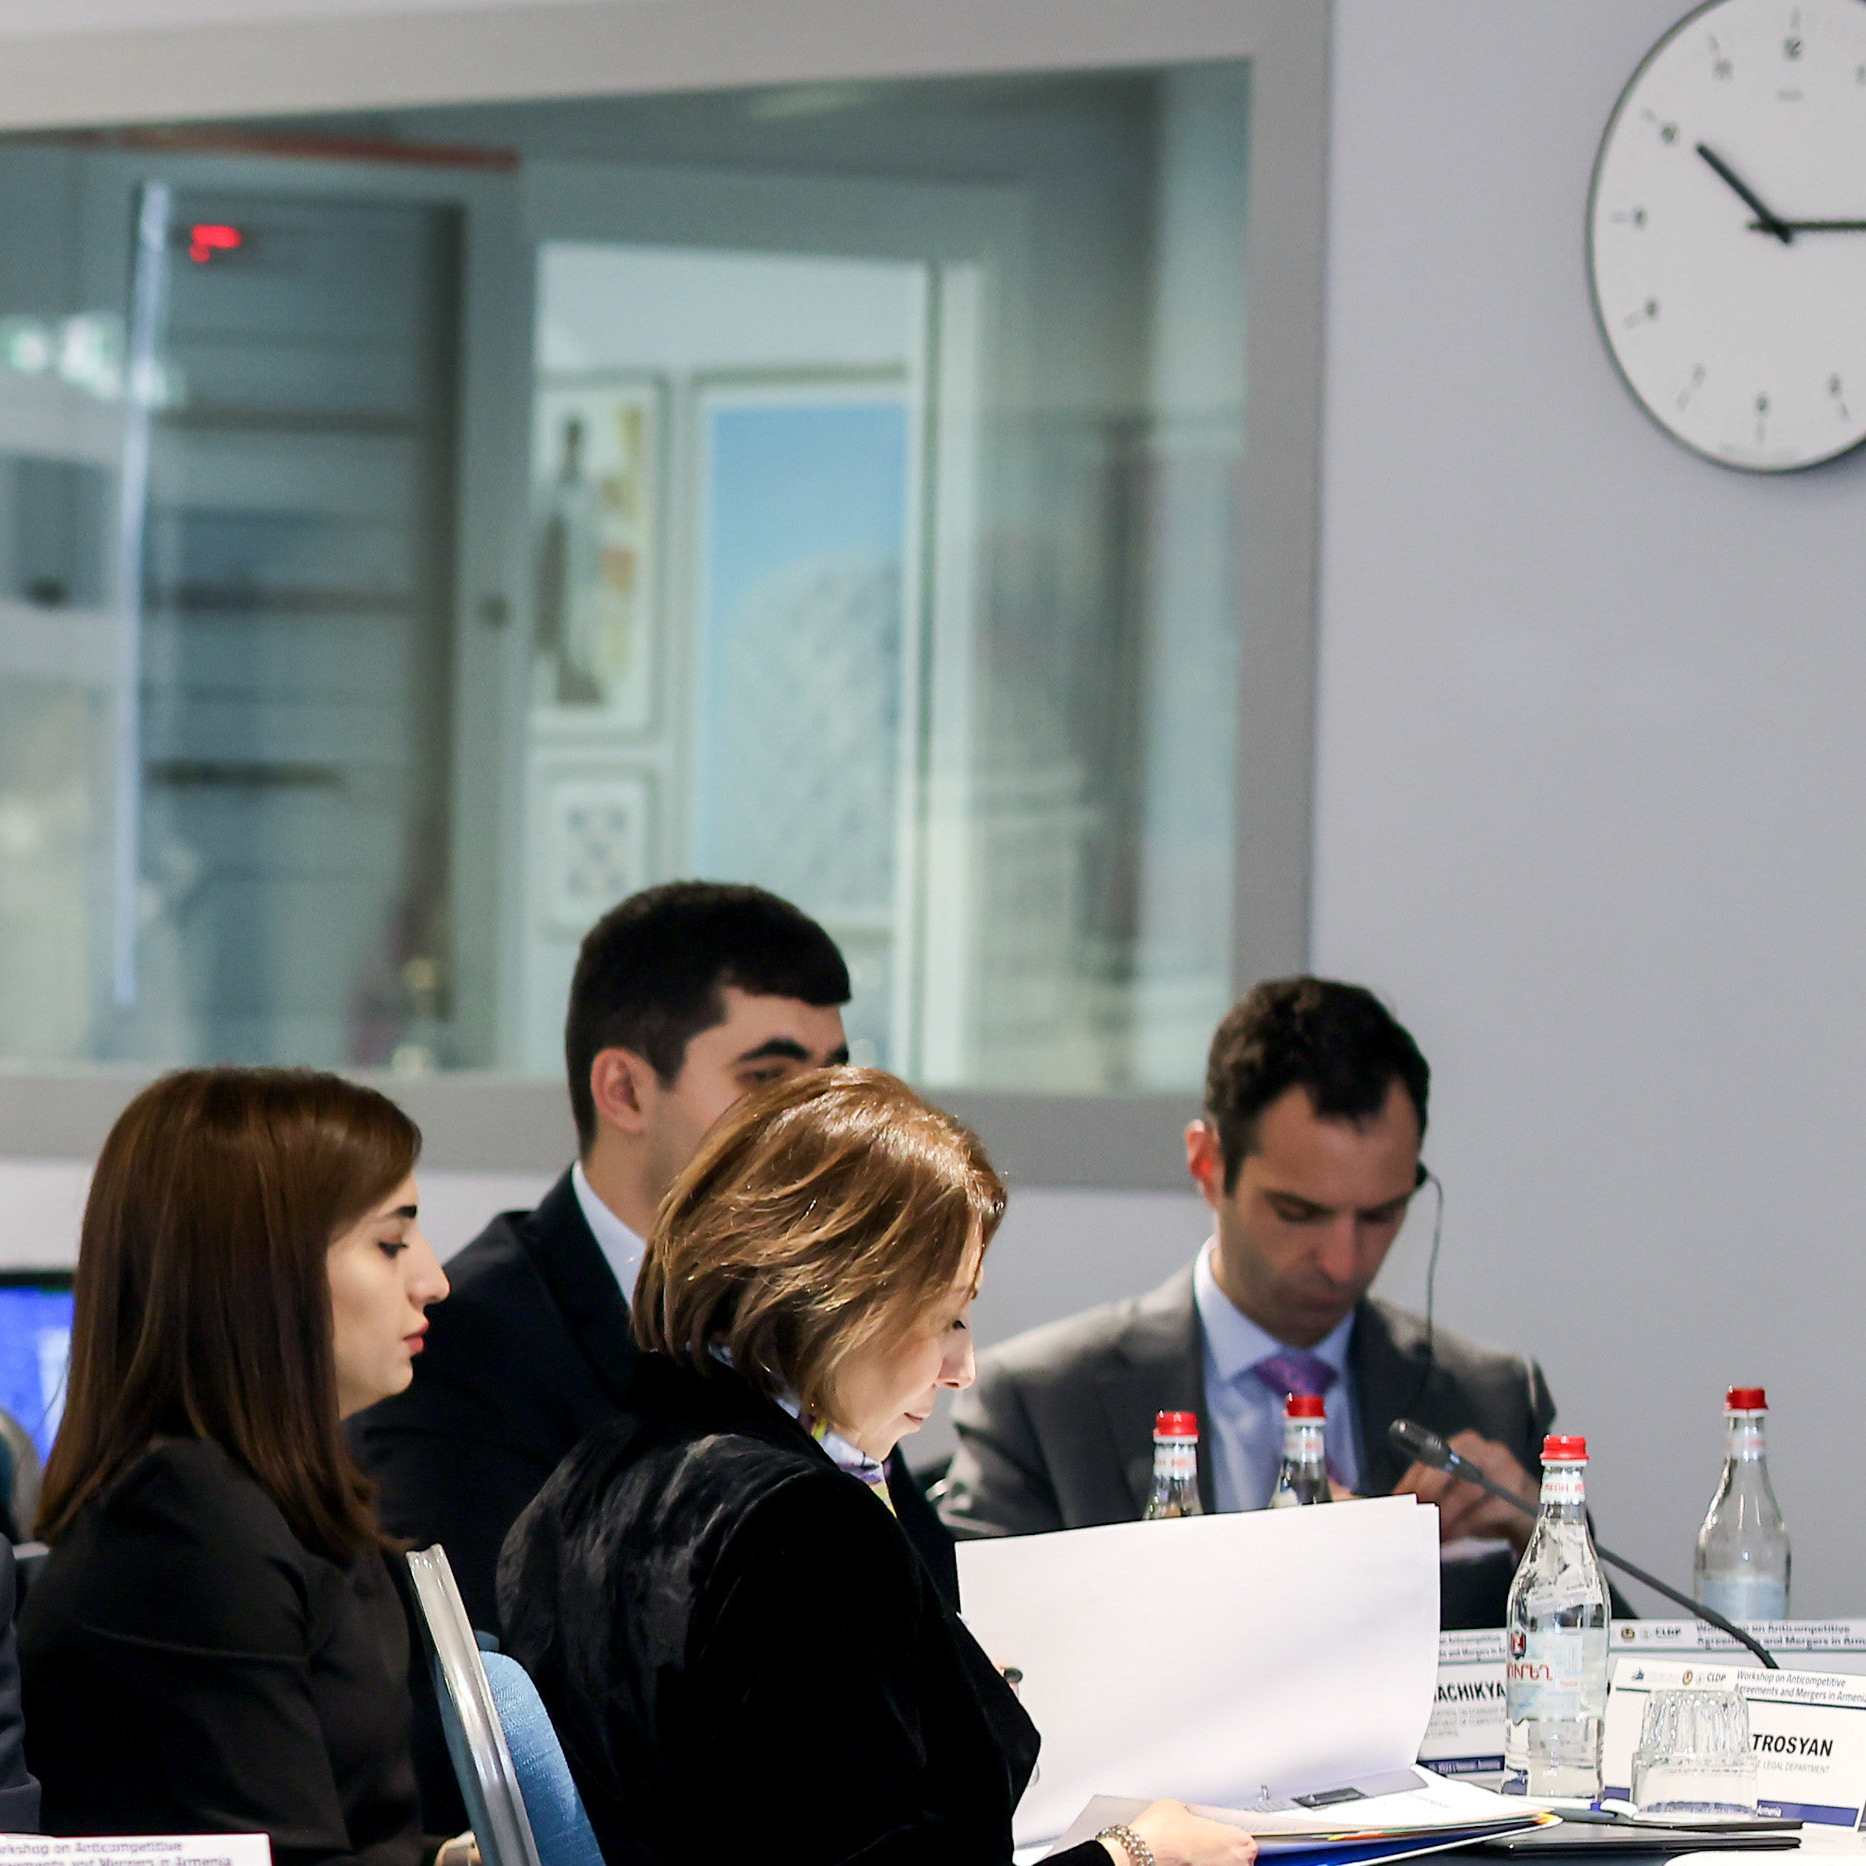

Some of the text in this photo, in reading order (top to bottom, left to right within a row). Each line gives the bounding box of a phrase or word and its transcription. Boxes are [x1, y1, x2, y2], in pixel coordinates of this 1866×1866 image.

[1737, 1670, 1846, 1688] Workshop on Anticompetitive
[1434, 1681, 1506, 1702] ACHIKYA
[1734, 1683, 1779, 1697] Agreements
[1780, 1686, 1794, 1697] and
[1796, 1689, 1826, 1702] Mergers
[1828, 1690, 1836, 1699] in
[1752, 1733, 1834, 1757] TROSYAN
[1763, 1761, 1783, 1771] LEGAL
[1785, 1762, 1830, 1775] DEPARTMENT
[53, 1844, 70, 1854] on
